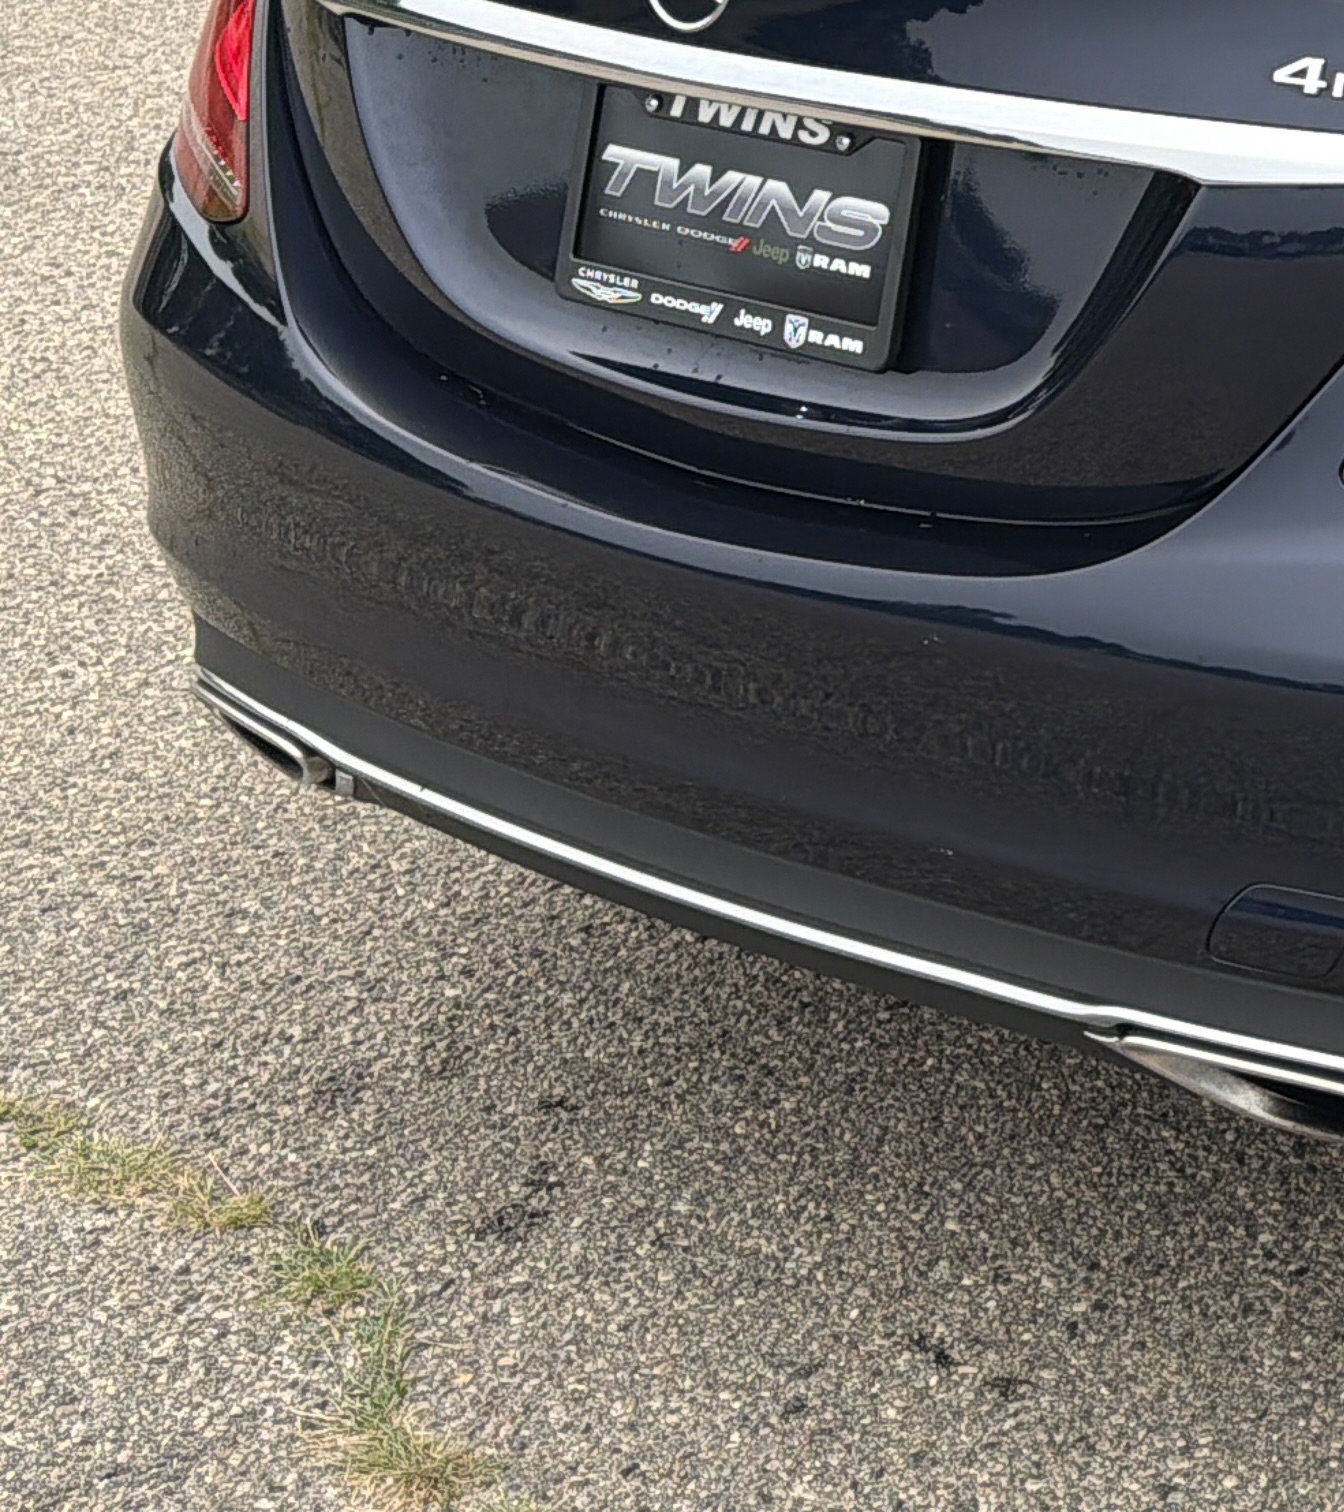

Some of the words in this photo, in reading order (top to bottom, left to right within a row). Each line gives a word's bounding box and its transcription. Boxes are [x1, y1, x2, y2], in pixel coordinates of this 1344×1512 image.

[601, 143, 890, 251] TWINS
[599, 208, 671, 232] CHRYSLER
[676, 225, 735, 246] DODGE
[752, 239, 790, 265] Jeep
[812, 253, 872, 279] RAM
[578, 267, 639, 289] CHRYSLER
[650, 293, 712, 315] DODGE
[733, 309, 772, 336] Jeep
[808, 329, 864, 355] RAM
